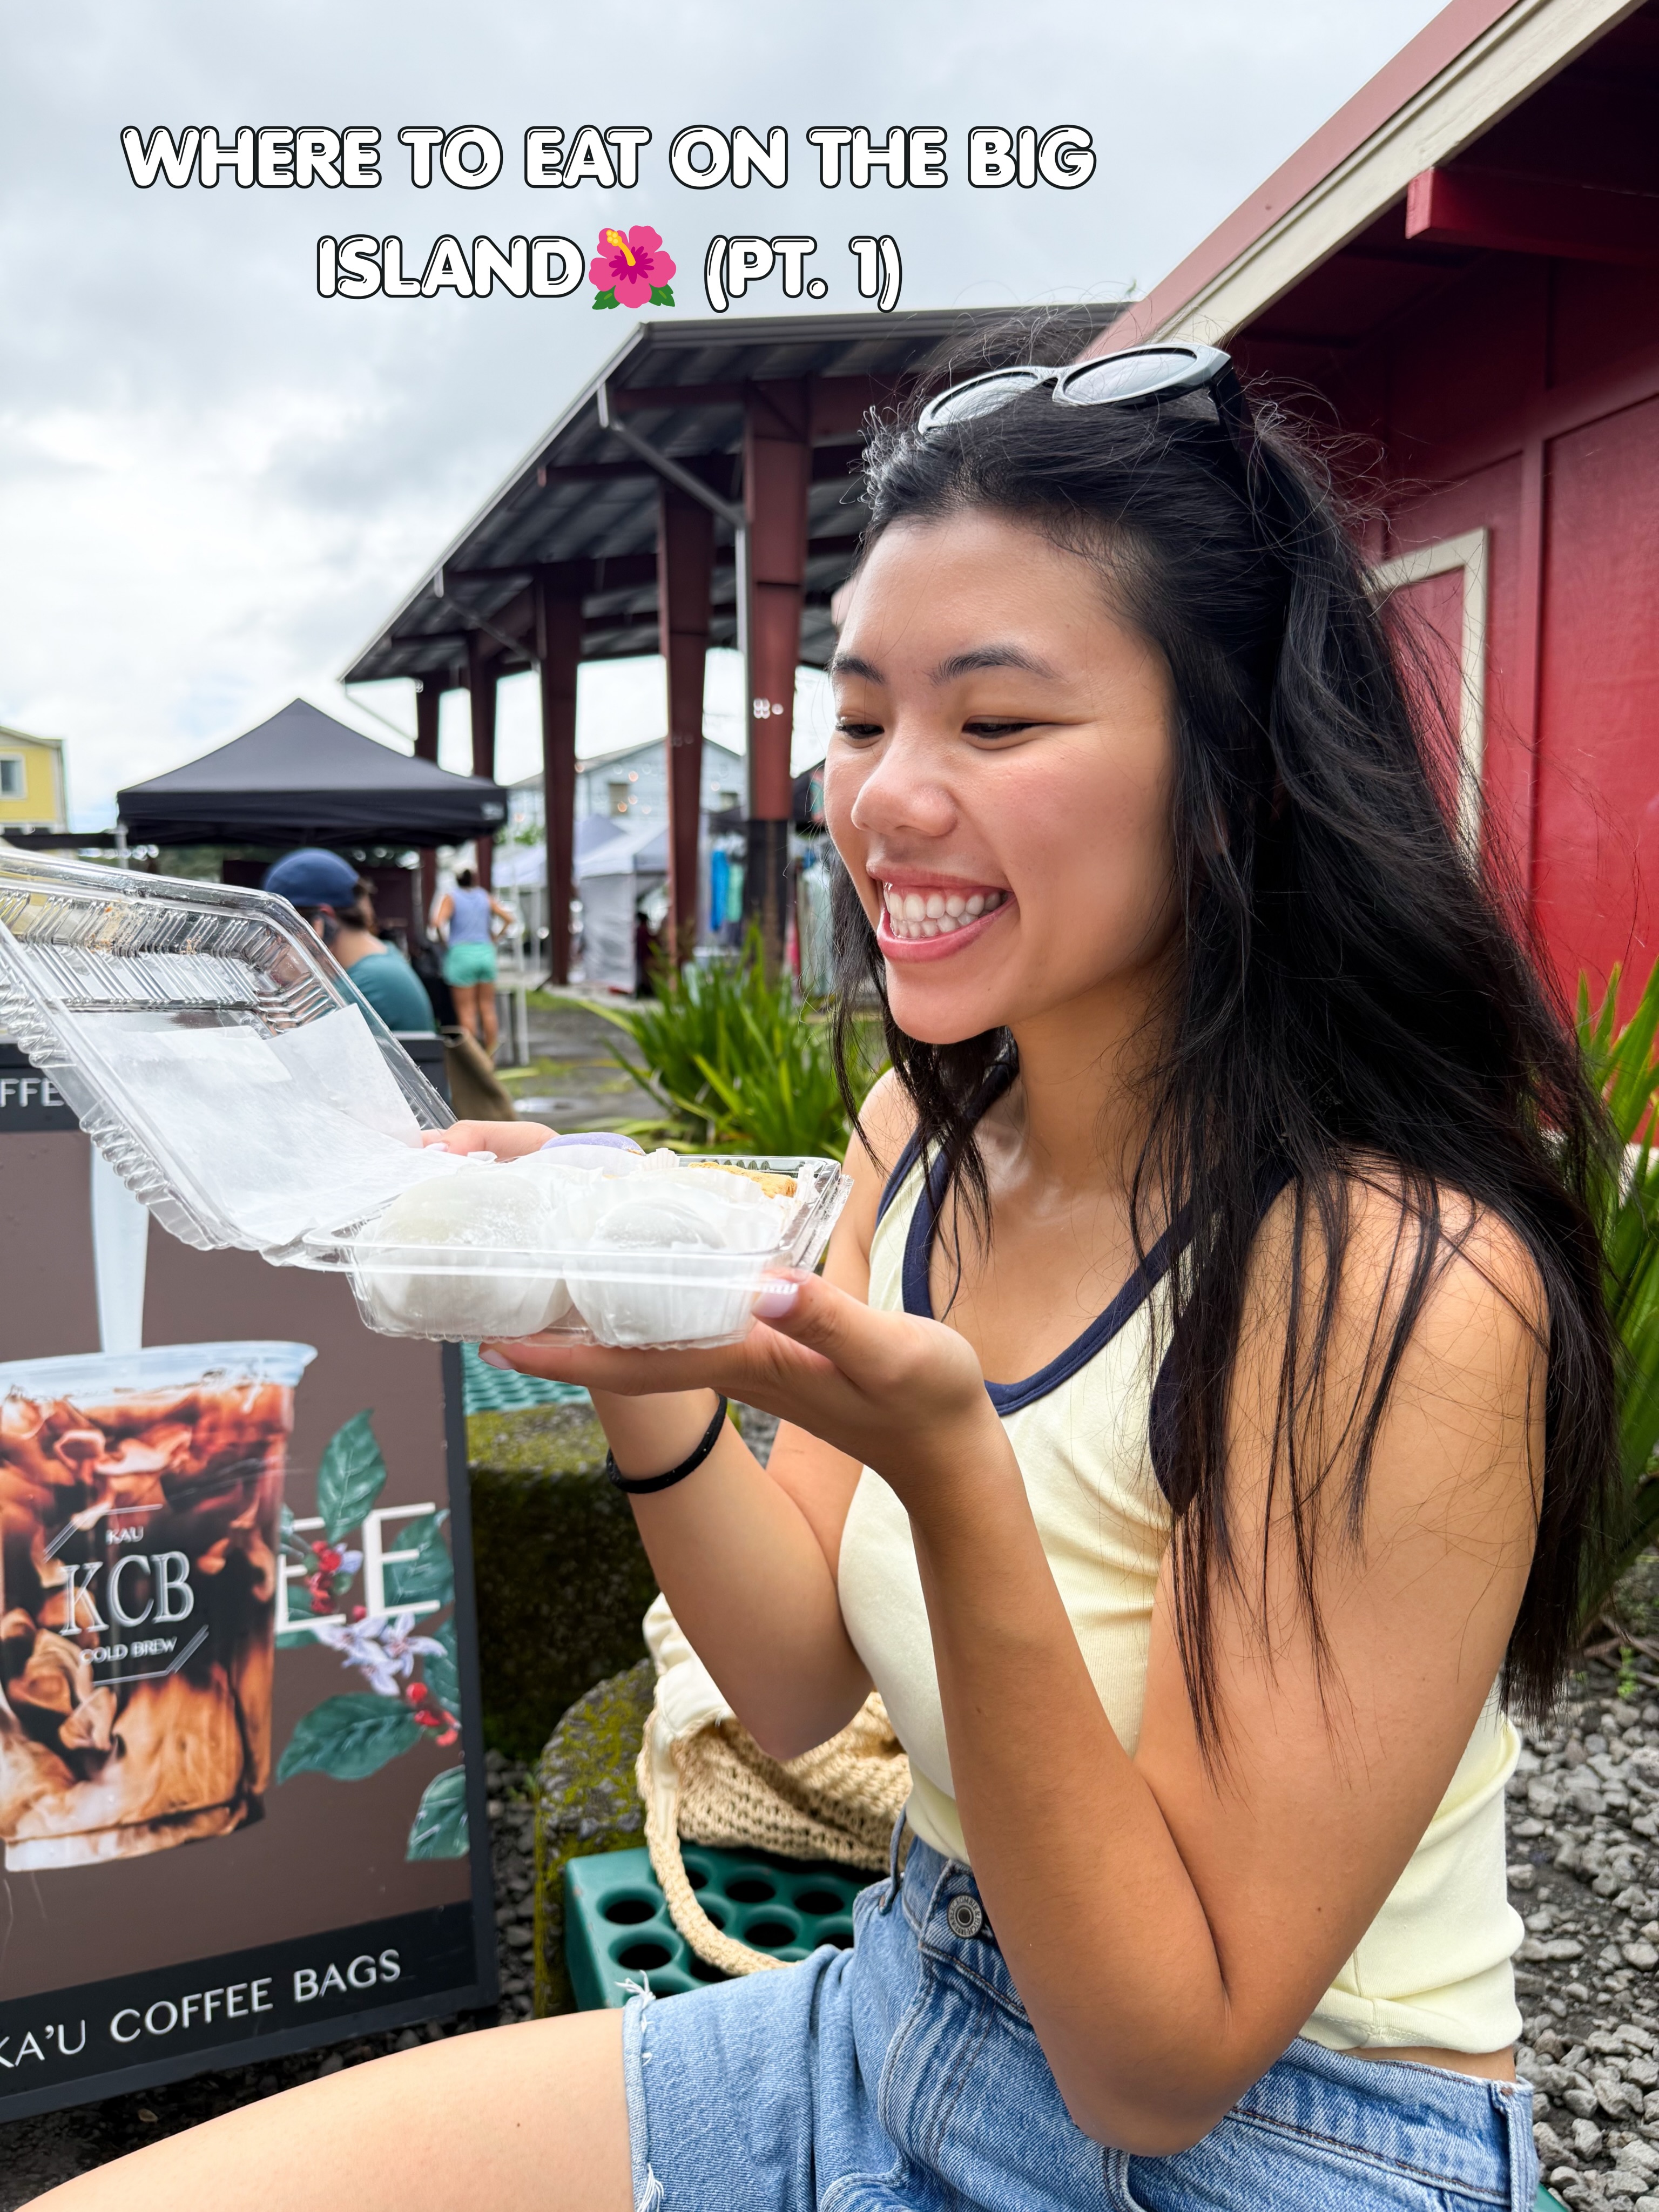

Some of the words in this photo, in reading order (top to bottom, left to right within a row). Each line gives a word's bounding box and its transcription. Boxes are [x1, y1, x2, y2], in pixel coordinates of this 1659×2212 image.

[106, 1526, 144, 1545] KAU
[59, 1551, 194, 1636] KCB
[80, 1644, 128, 1663] COLD
[130, 1636, 177, 1658] BREW
[110, 1978, 273, 2043] COFFEE
[294, 1949, 401, 2002] BAGS
